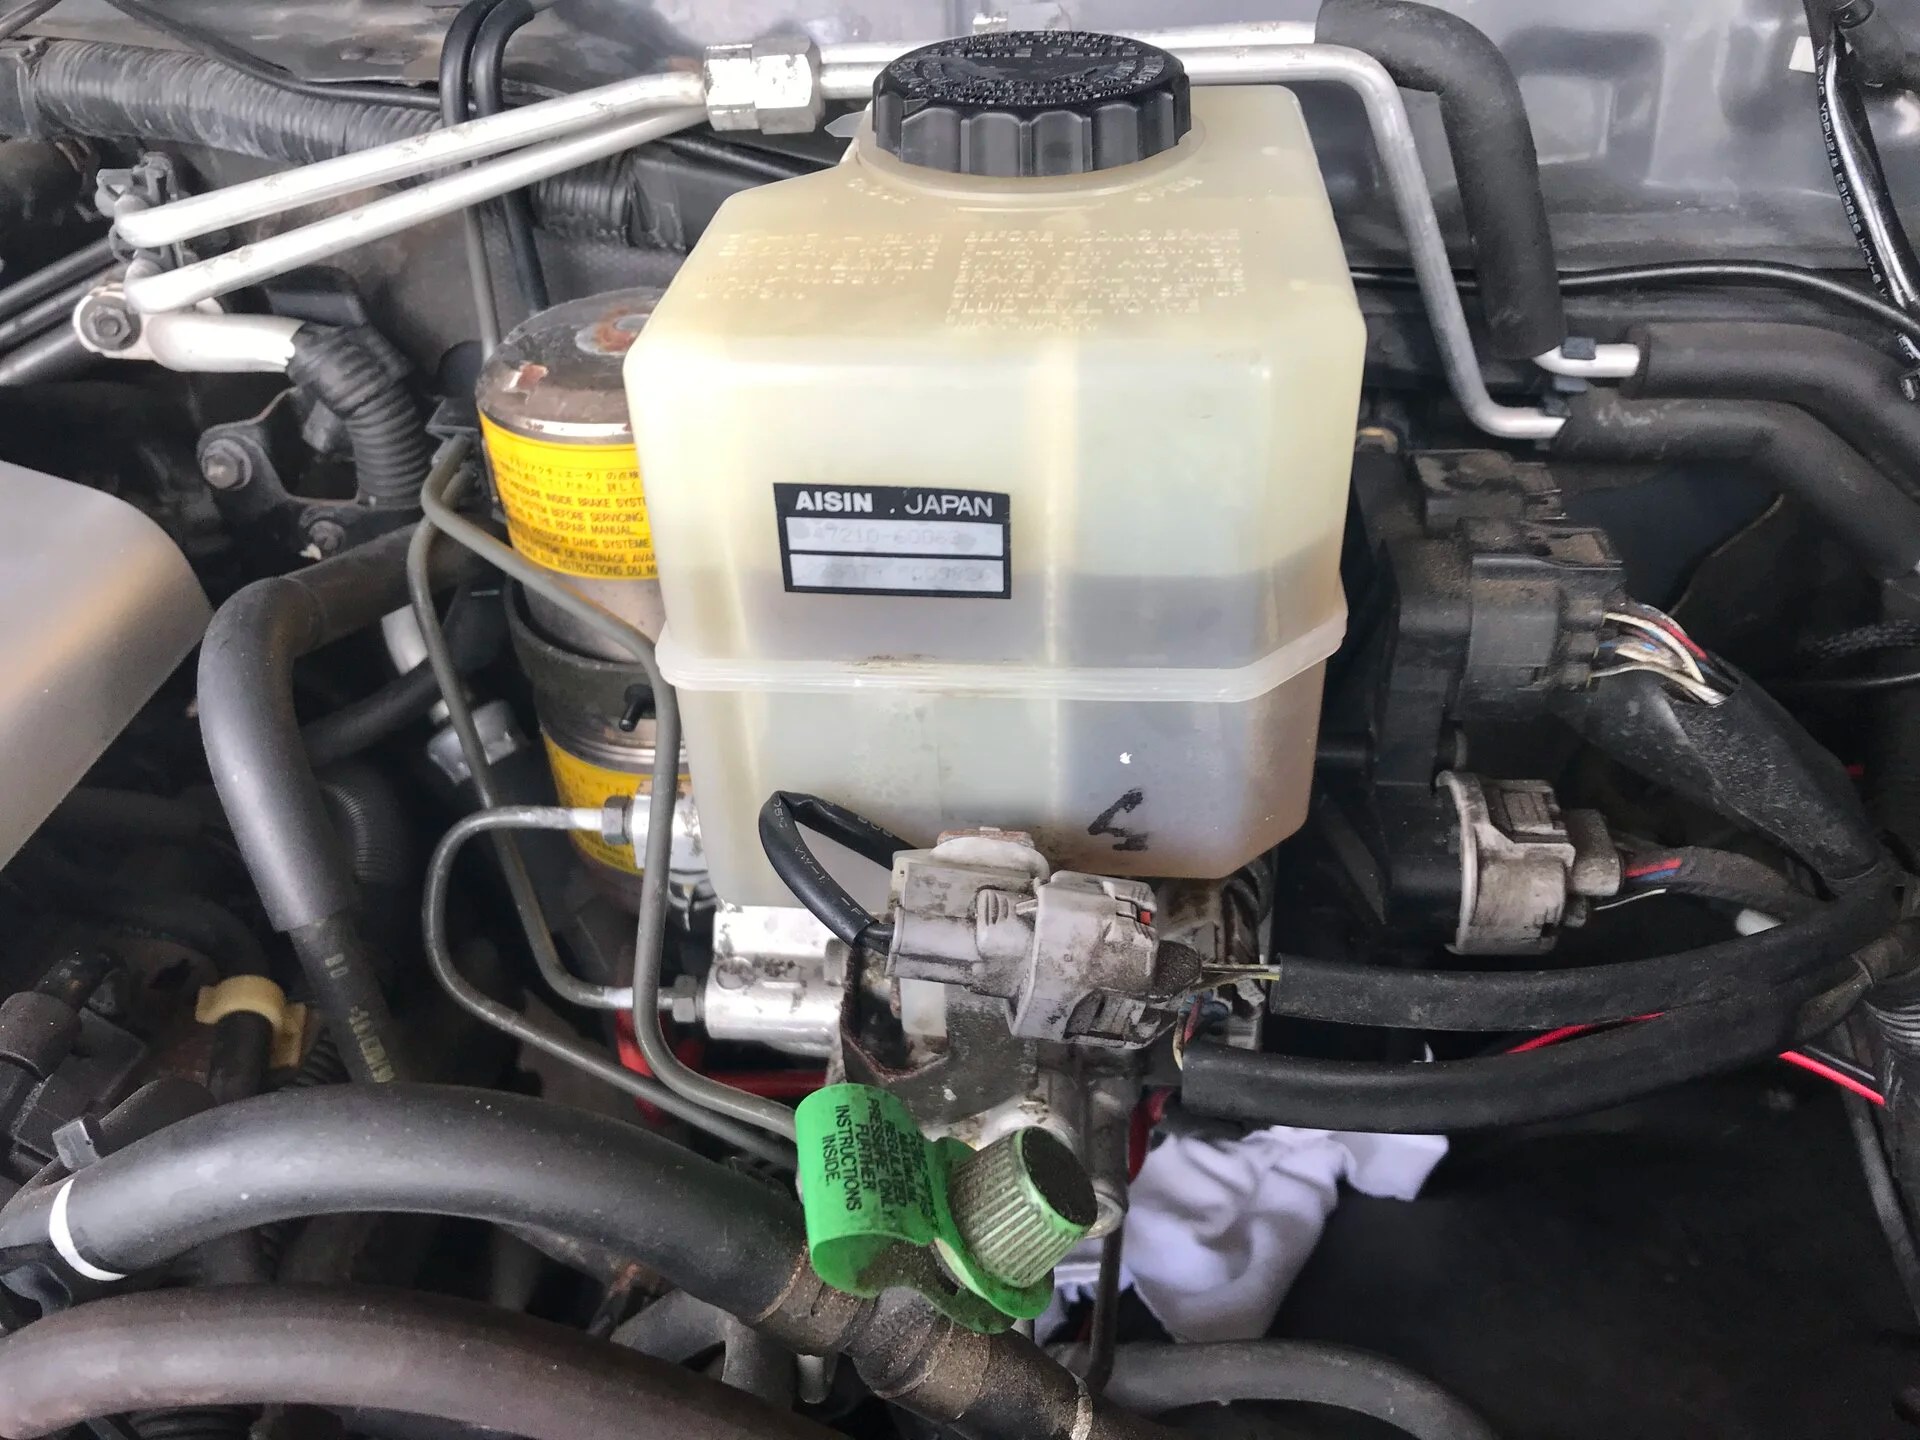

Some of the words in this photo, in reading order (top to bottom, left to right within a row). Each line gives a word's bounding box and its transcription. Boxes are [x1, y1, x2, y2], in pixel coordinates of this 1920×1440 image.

[551, 507, 583, 519] BEFORE
[590, 511, 644, 523] SERVICING
[577, 496, 611, 508] BRAKE
[795, 490, 874, 513] AISIN
[904, 494, 994, 517] JAPAN
[555, 519, 585, 531] REPAIR
[626, 563, 642, 577] DU
[822, 1134, 840, 1186] INSIDE.
[835, 1104, 862, 1211] INSTRUCTIONS
[856, 1123, 877, 1190] FURTHER
[867, 1097, 889, 1172] PRESSURE
[878, 1178, 897, 1219] ONLY
